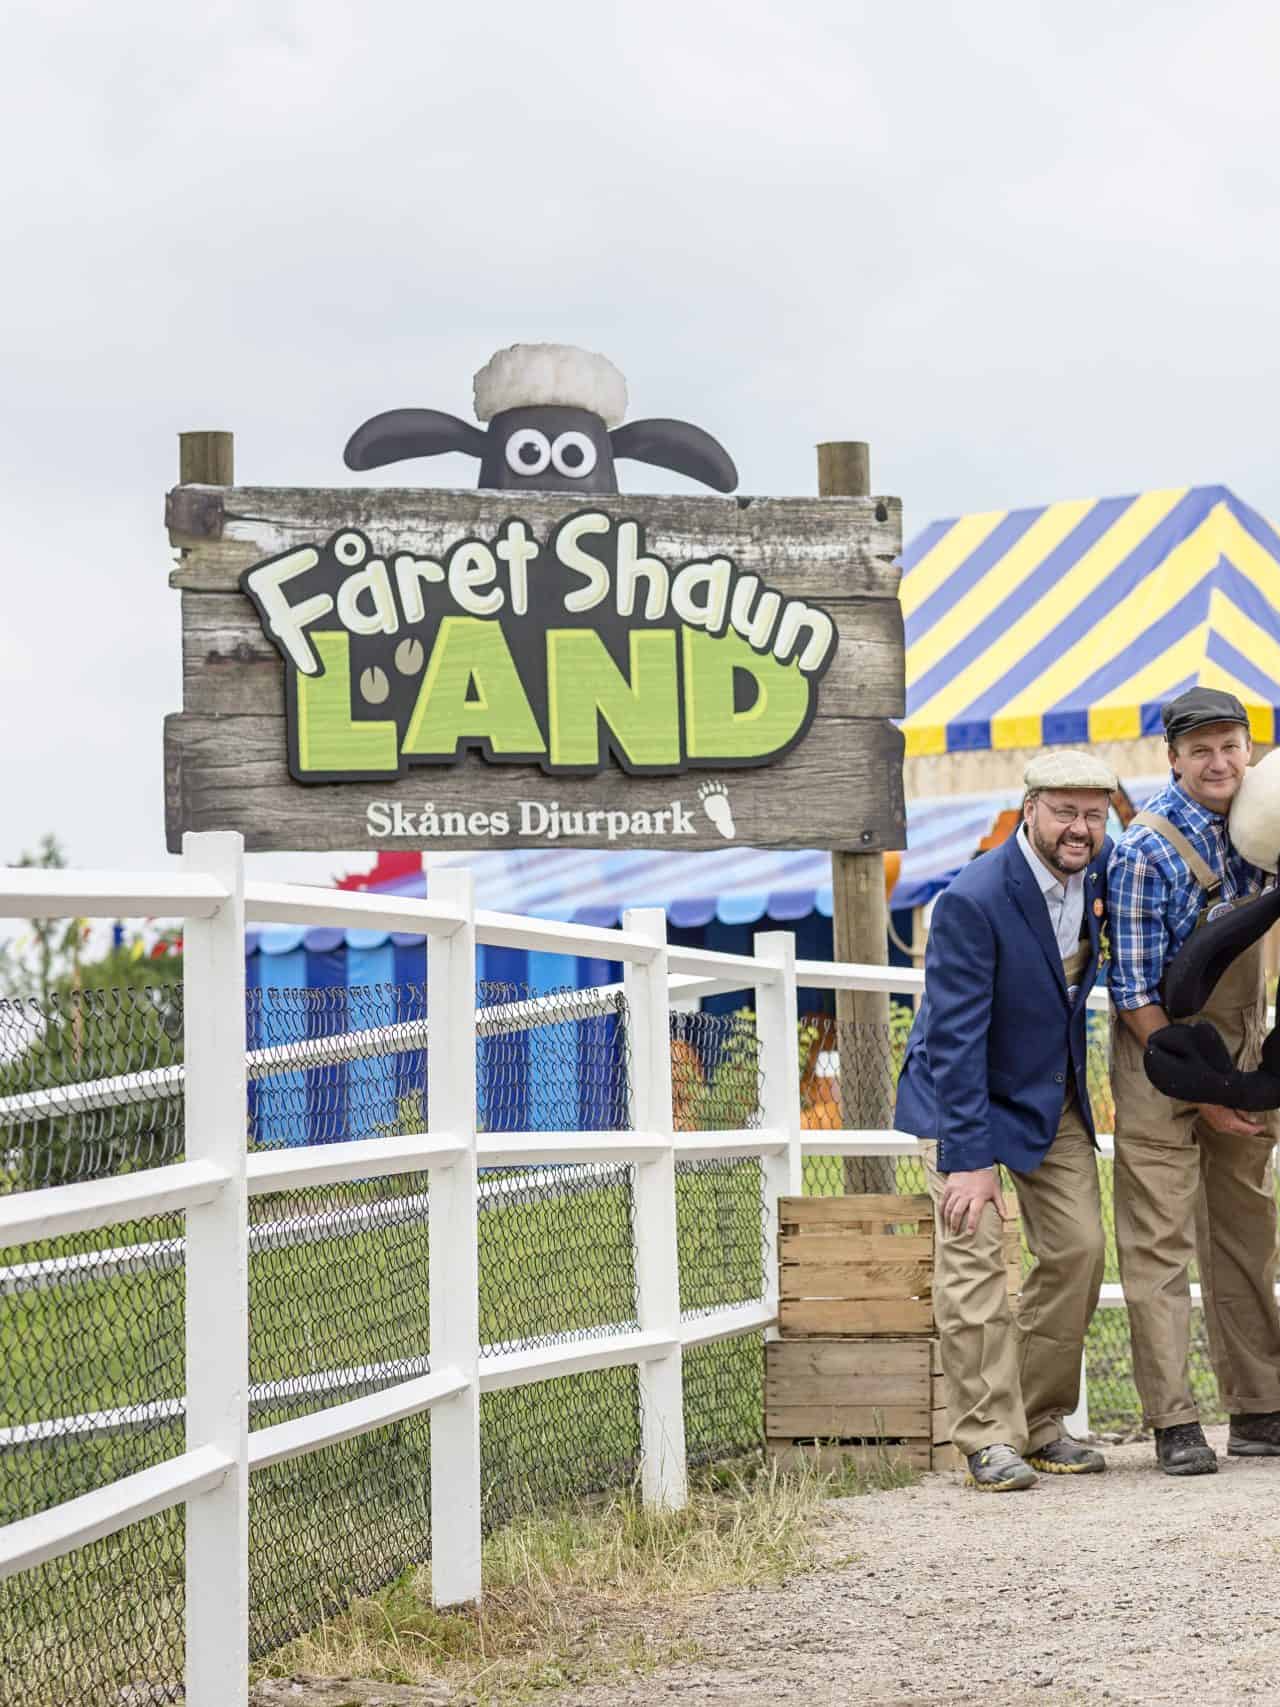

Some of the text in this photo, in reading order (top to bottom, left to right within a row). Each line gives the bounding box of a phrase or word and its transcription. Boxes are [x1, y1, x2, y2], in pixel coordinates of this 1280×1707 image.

[248, 512, 833, 675] Fåret Shaun
[297, 616, 810, 771] LAND
[366, 800, 697, 840] Skånes Djurpark
